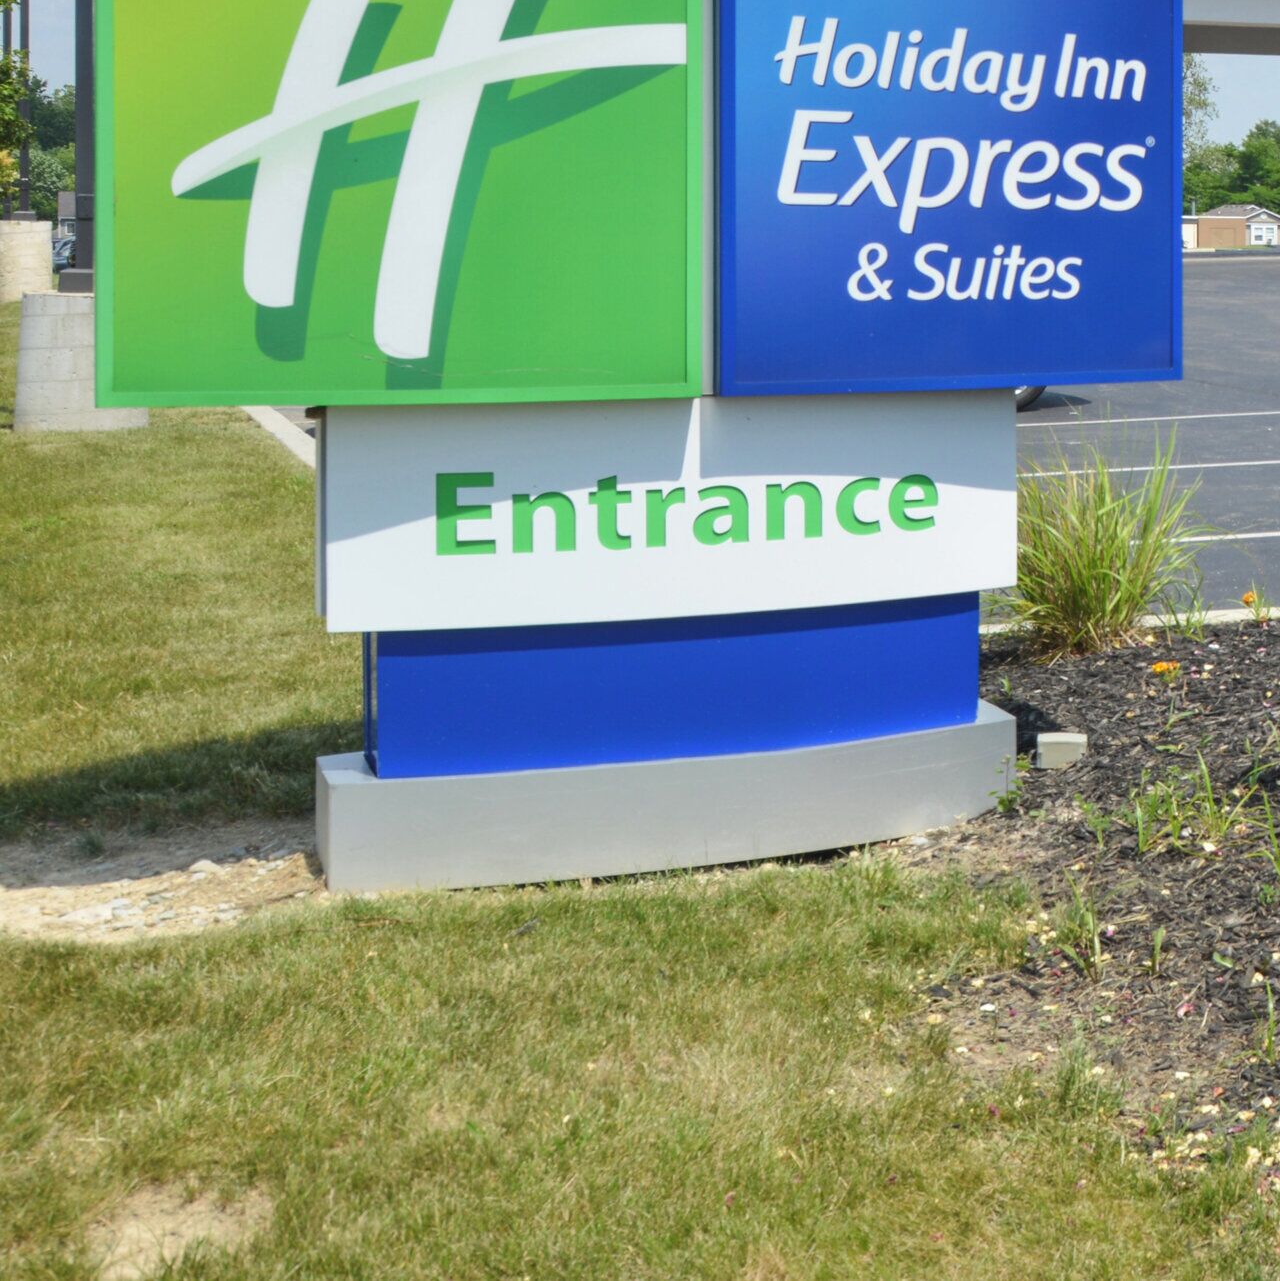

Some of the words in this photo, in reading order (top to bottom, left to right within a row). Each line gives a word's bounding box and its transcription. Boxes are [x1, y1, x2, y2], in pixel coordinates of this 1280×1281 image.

[774, 15, 1047, 112] Holiday
[1054, 33, 1147, 102] Inn
[846, 242, 893, 301] &
[907, 242, 1082, 300] Suites
[436, 472, 940, 556] Entrance
